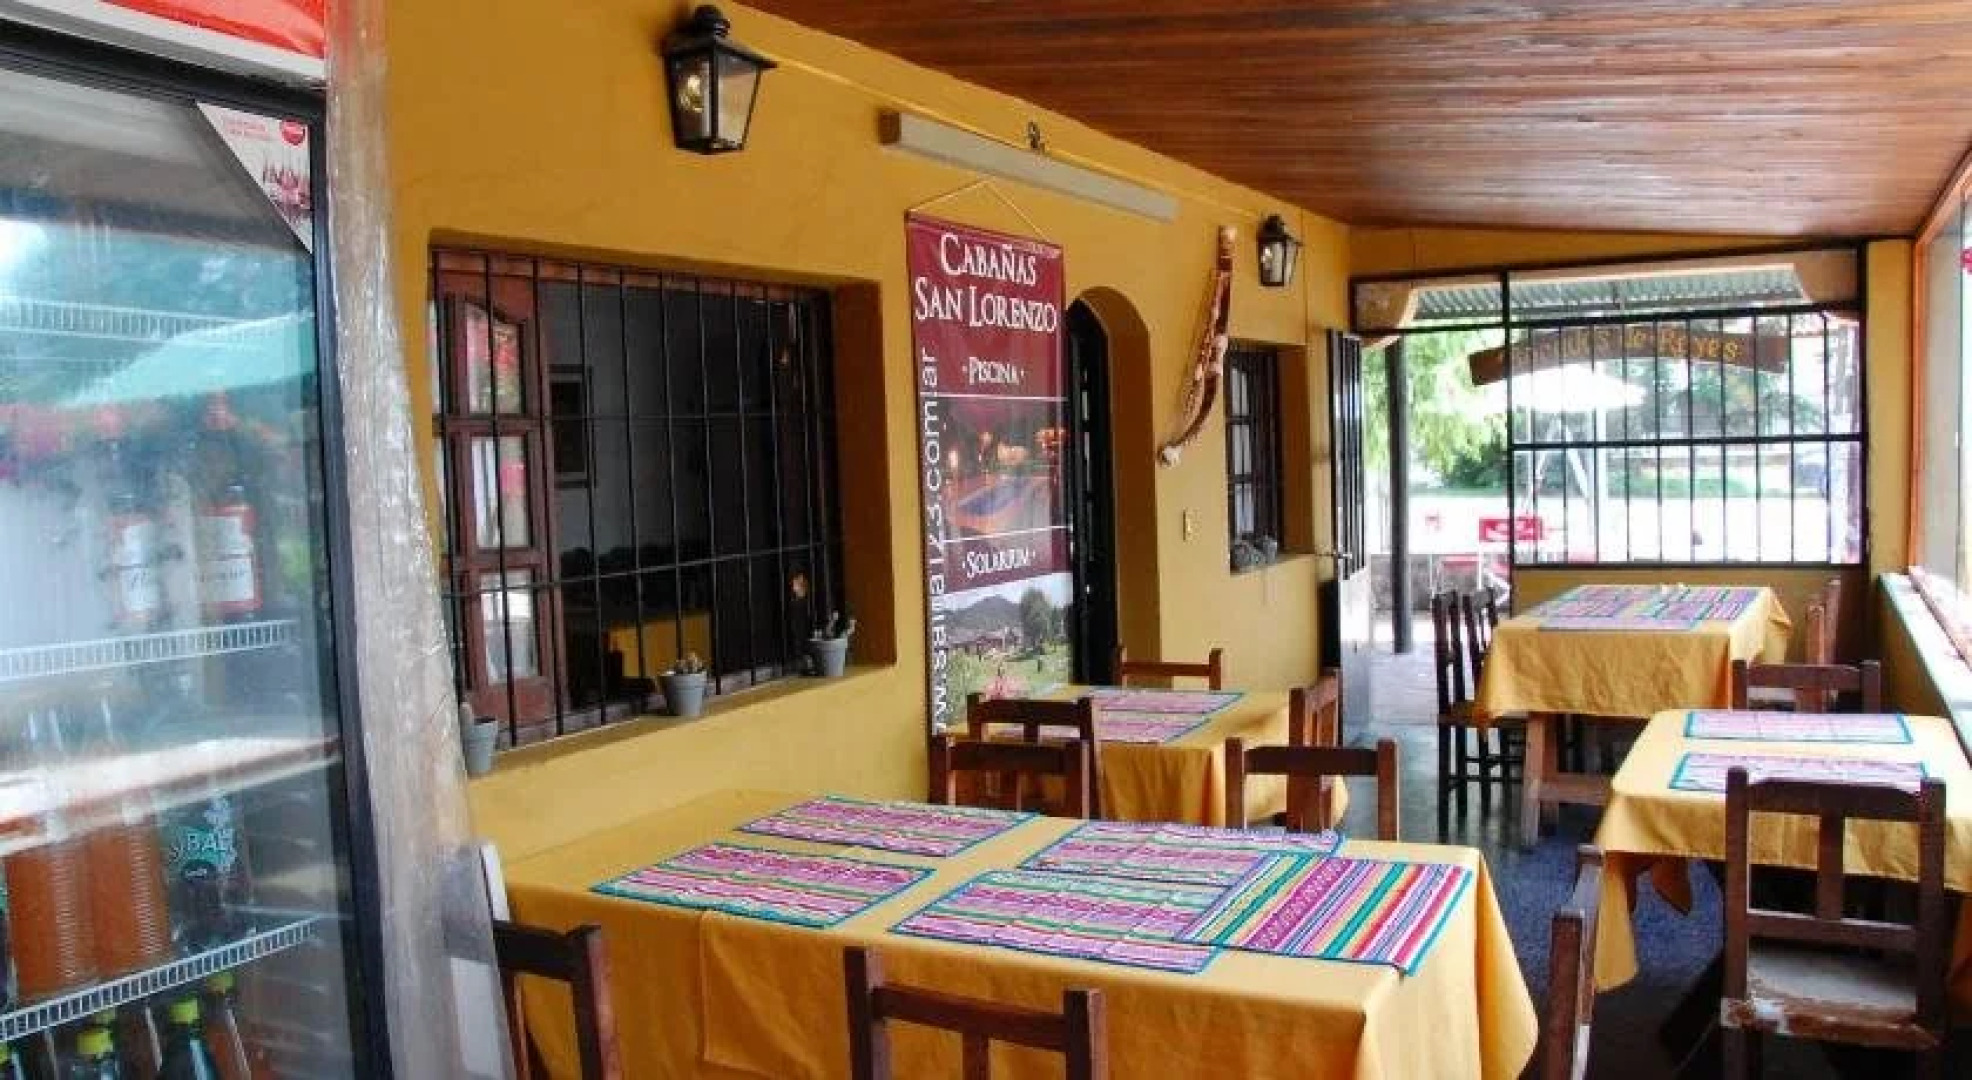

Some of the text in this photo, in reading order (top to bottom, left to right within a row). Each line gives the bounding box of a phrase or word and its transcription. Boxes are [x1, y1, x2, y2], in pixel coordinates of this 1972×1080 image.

[941, 231, 1036, 286] CABAÑAS
[914, 276, 1057, 333] SAN LORENZO
[968, 356, 1020, 386] PISCINA
